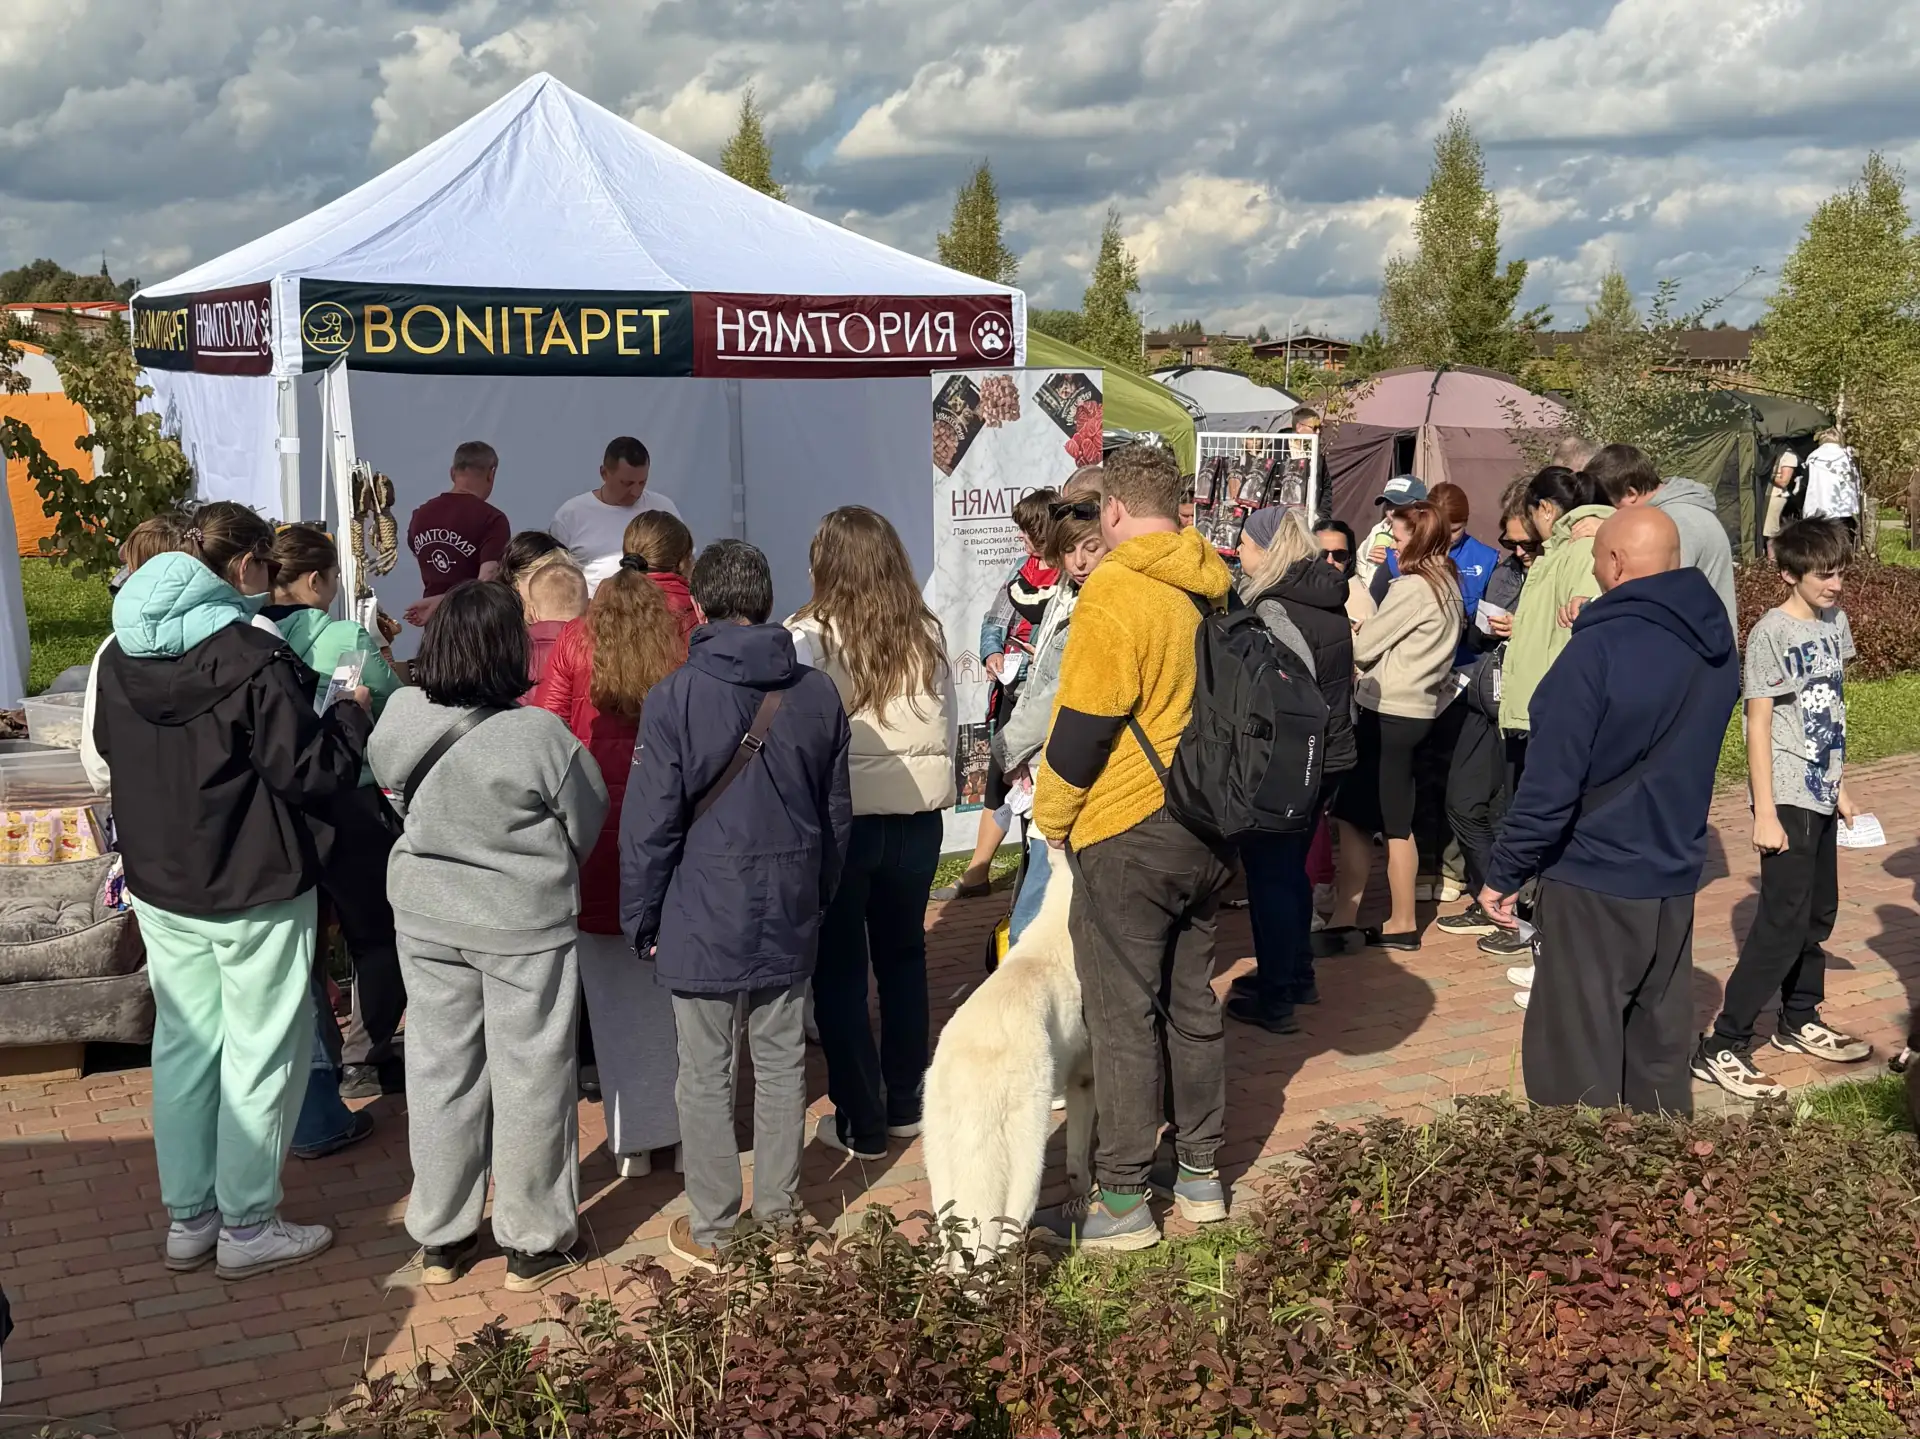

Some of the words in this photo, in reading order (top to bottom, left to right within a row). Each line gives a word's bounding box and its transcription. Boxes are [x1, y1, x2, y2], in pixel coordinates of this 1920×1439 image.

[140, 308, 188, 351] BONITAPET
[195, 300, 258, 347] НЯМТОРИЯ
[363, 304, 670, 355] BONITAPET
[716, 306, 958, 353] НЯМТОРИЯ
[952, 525, 1004, 537] Лакомства
[970, 537, 1012, 546] высоким
[976, 546, 1027, 556] натуральн
